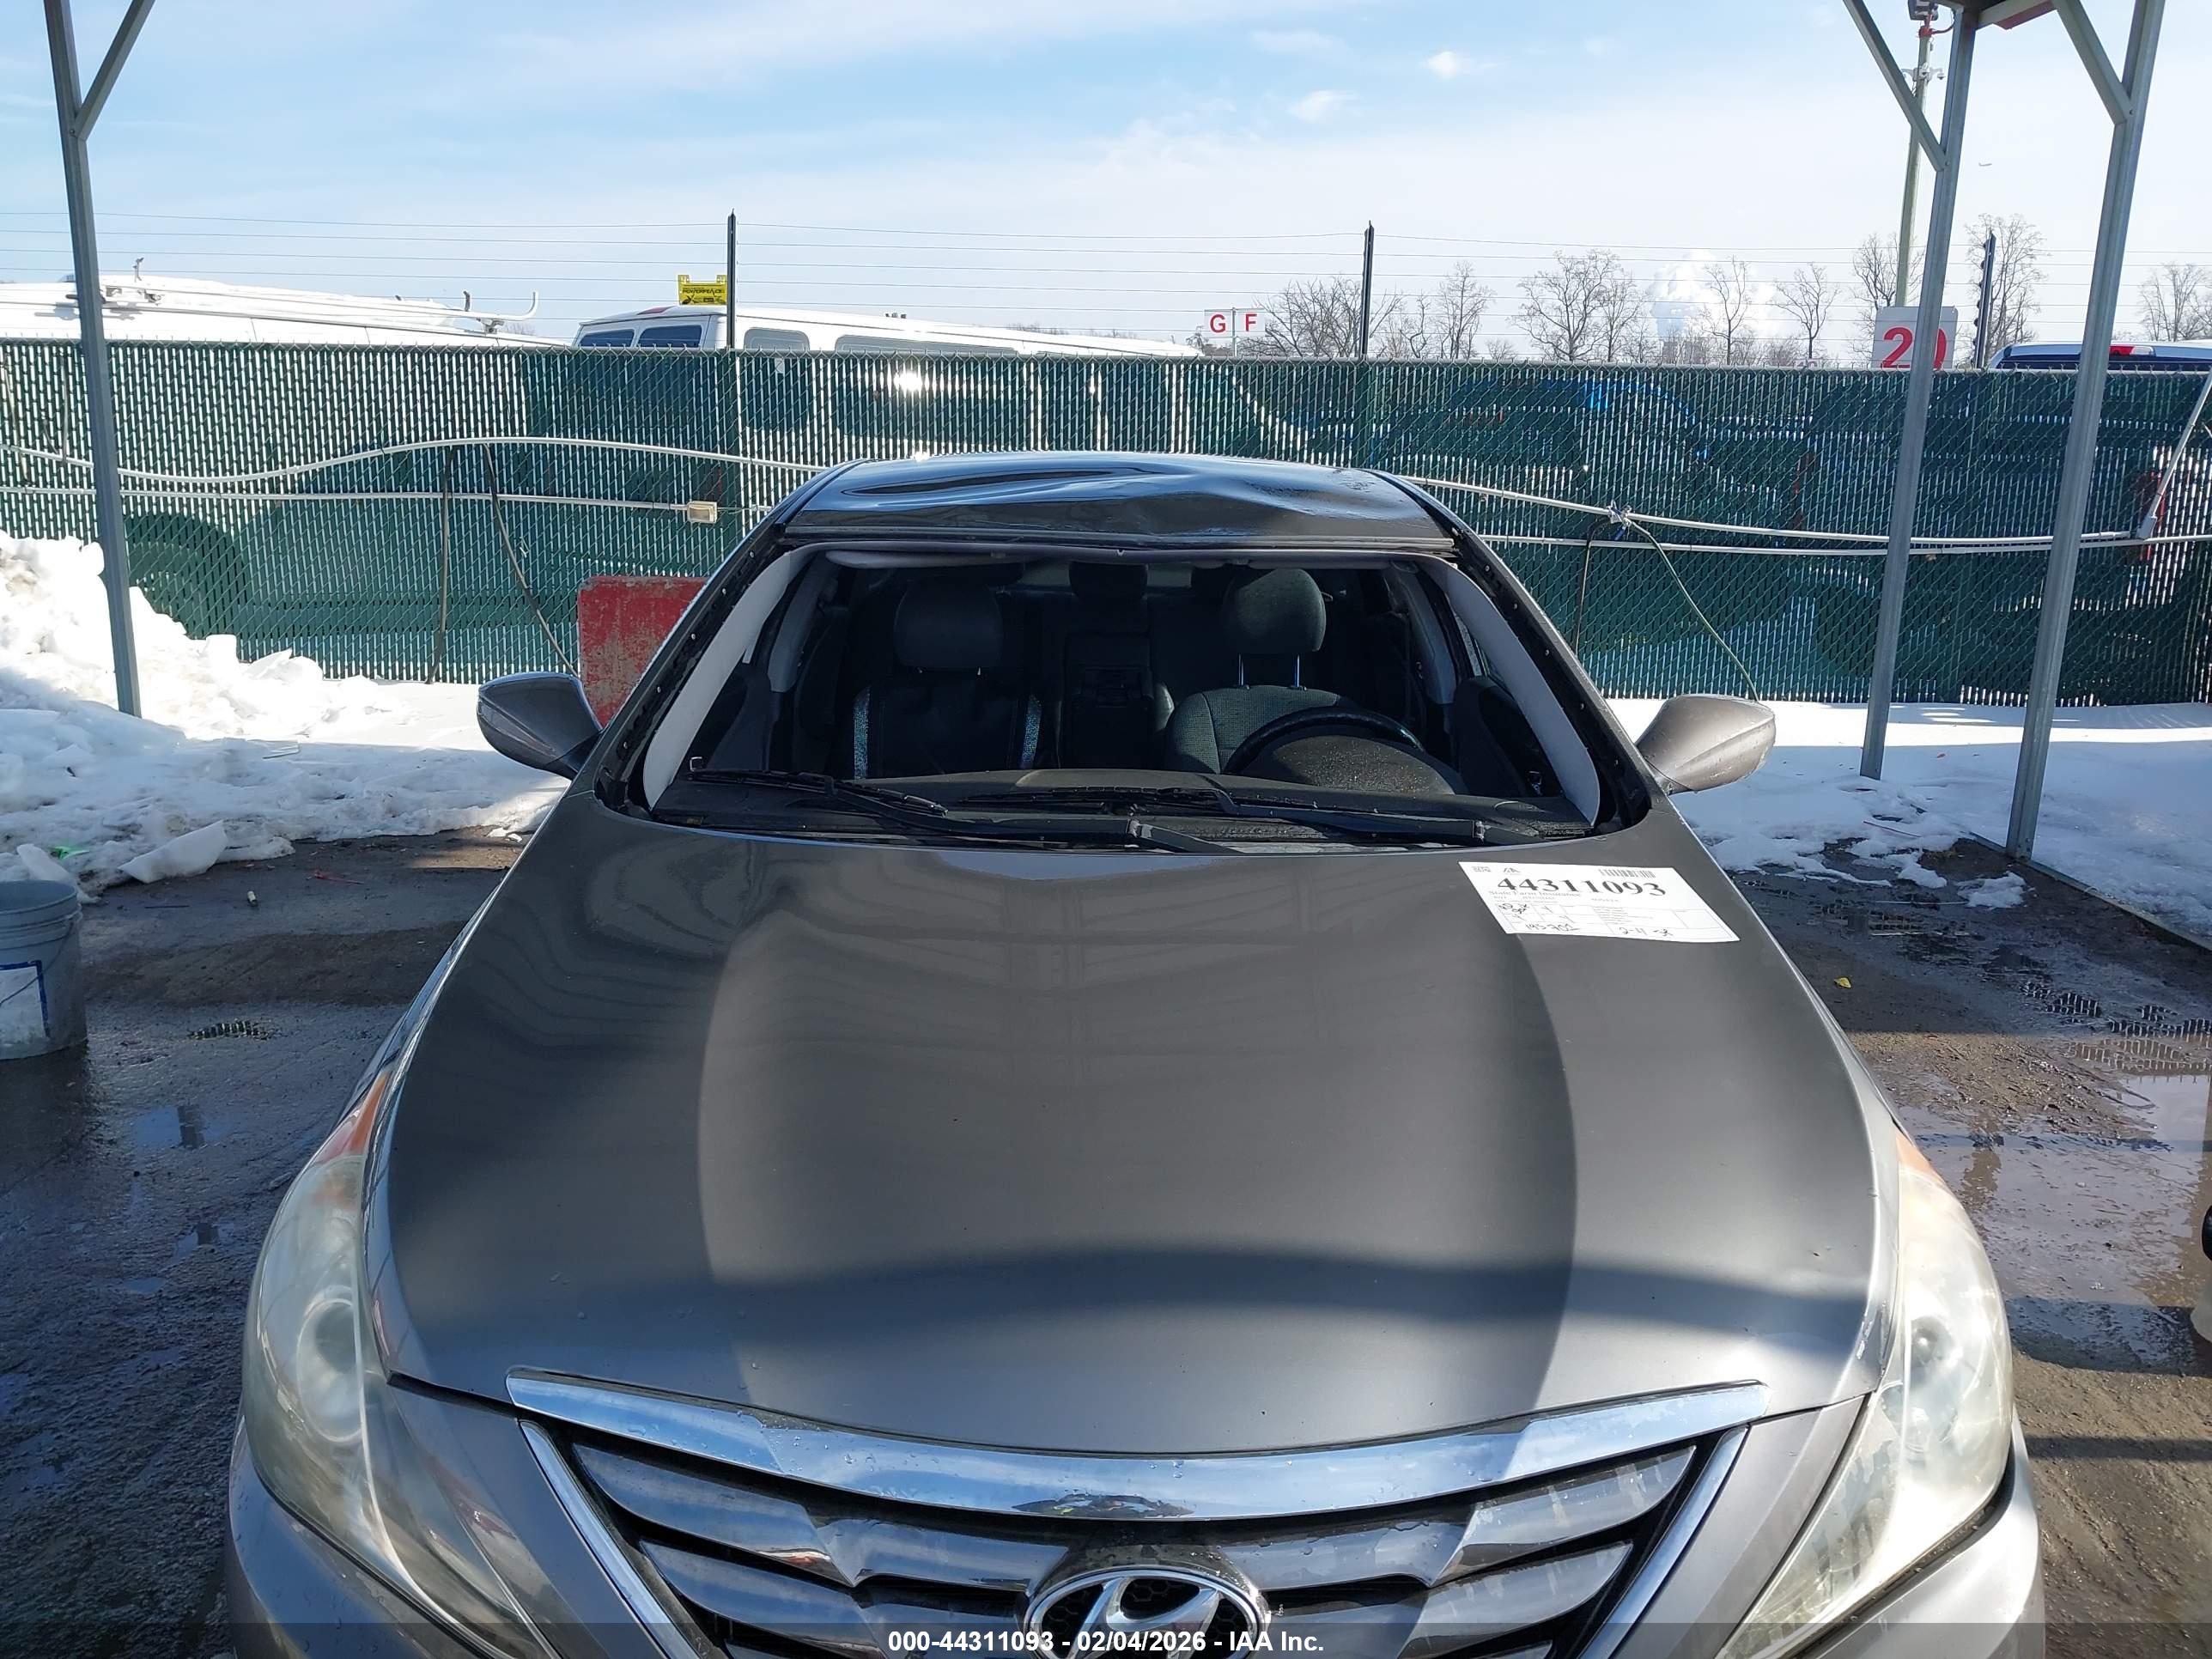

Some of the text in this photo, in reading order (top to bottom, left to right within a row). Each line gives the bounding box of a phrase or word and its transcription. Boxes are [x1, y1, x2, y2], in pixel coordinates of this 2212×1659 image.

[1210, 314, 1226, 333] G
[1245, 313, 1257, 332] F
[1498, 878, 1666, 896] 44311093
